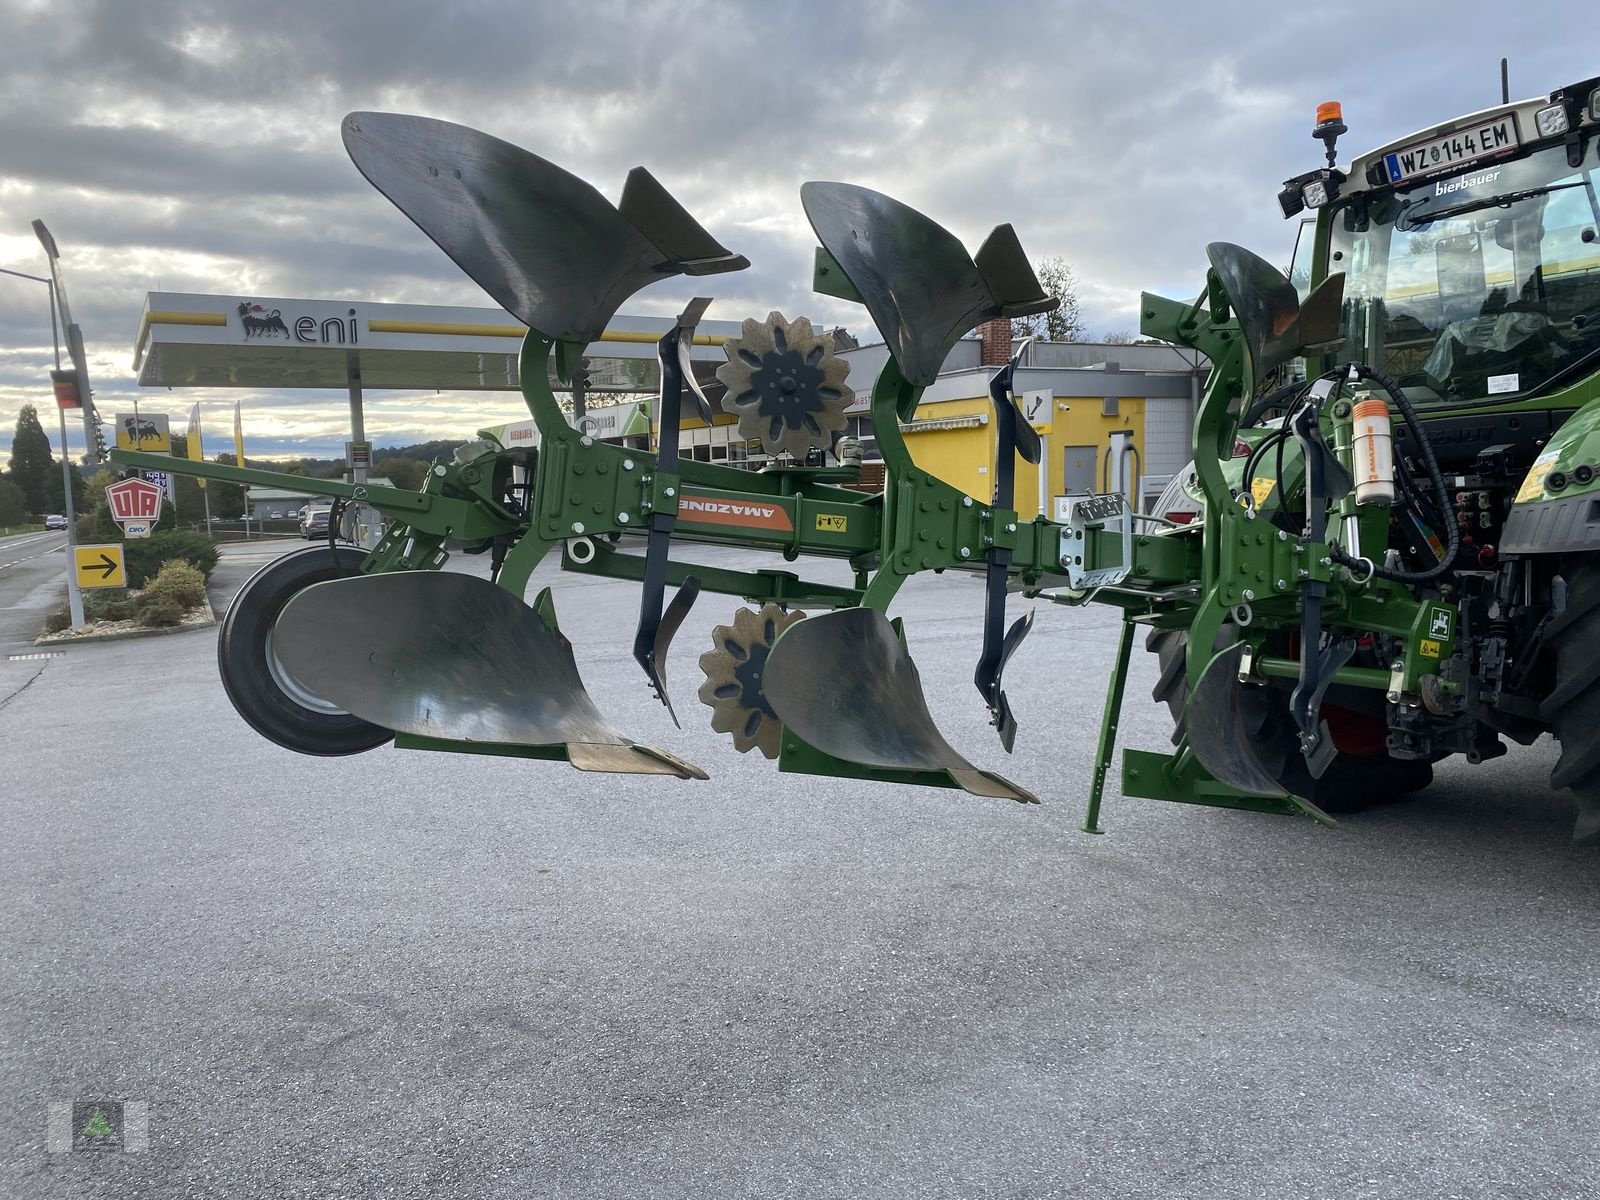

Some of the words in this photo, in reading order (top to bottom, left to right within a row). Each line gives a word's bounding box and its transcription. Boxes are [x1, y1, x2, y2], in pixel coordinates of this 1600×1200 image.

[1400, 148, 1430, 174] WZ
[1441, 134, 1477, 161] 144
[1479, 122, 1510, 151] EM
[1393, 170, 1399, 178] A
[1435, 171, 1501, 197] bierbauer
[294, 308, 358, 344] eni
[111, 480, 159, 517] UTA
